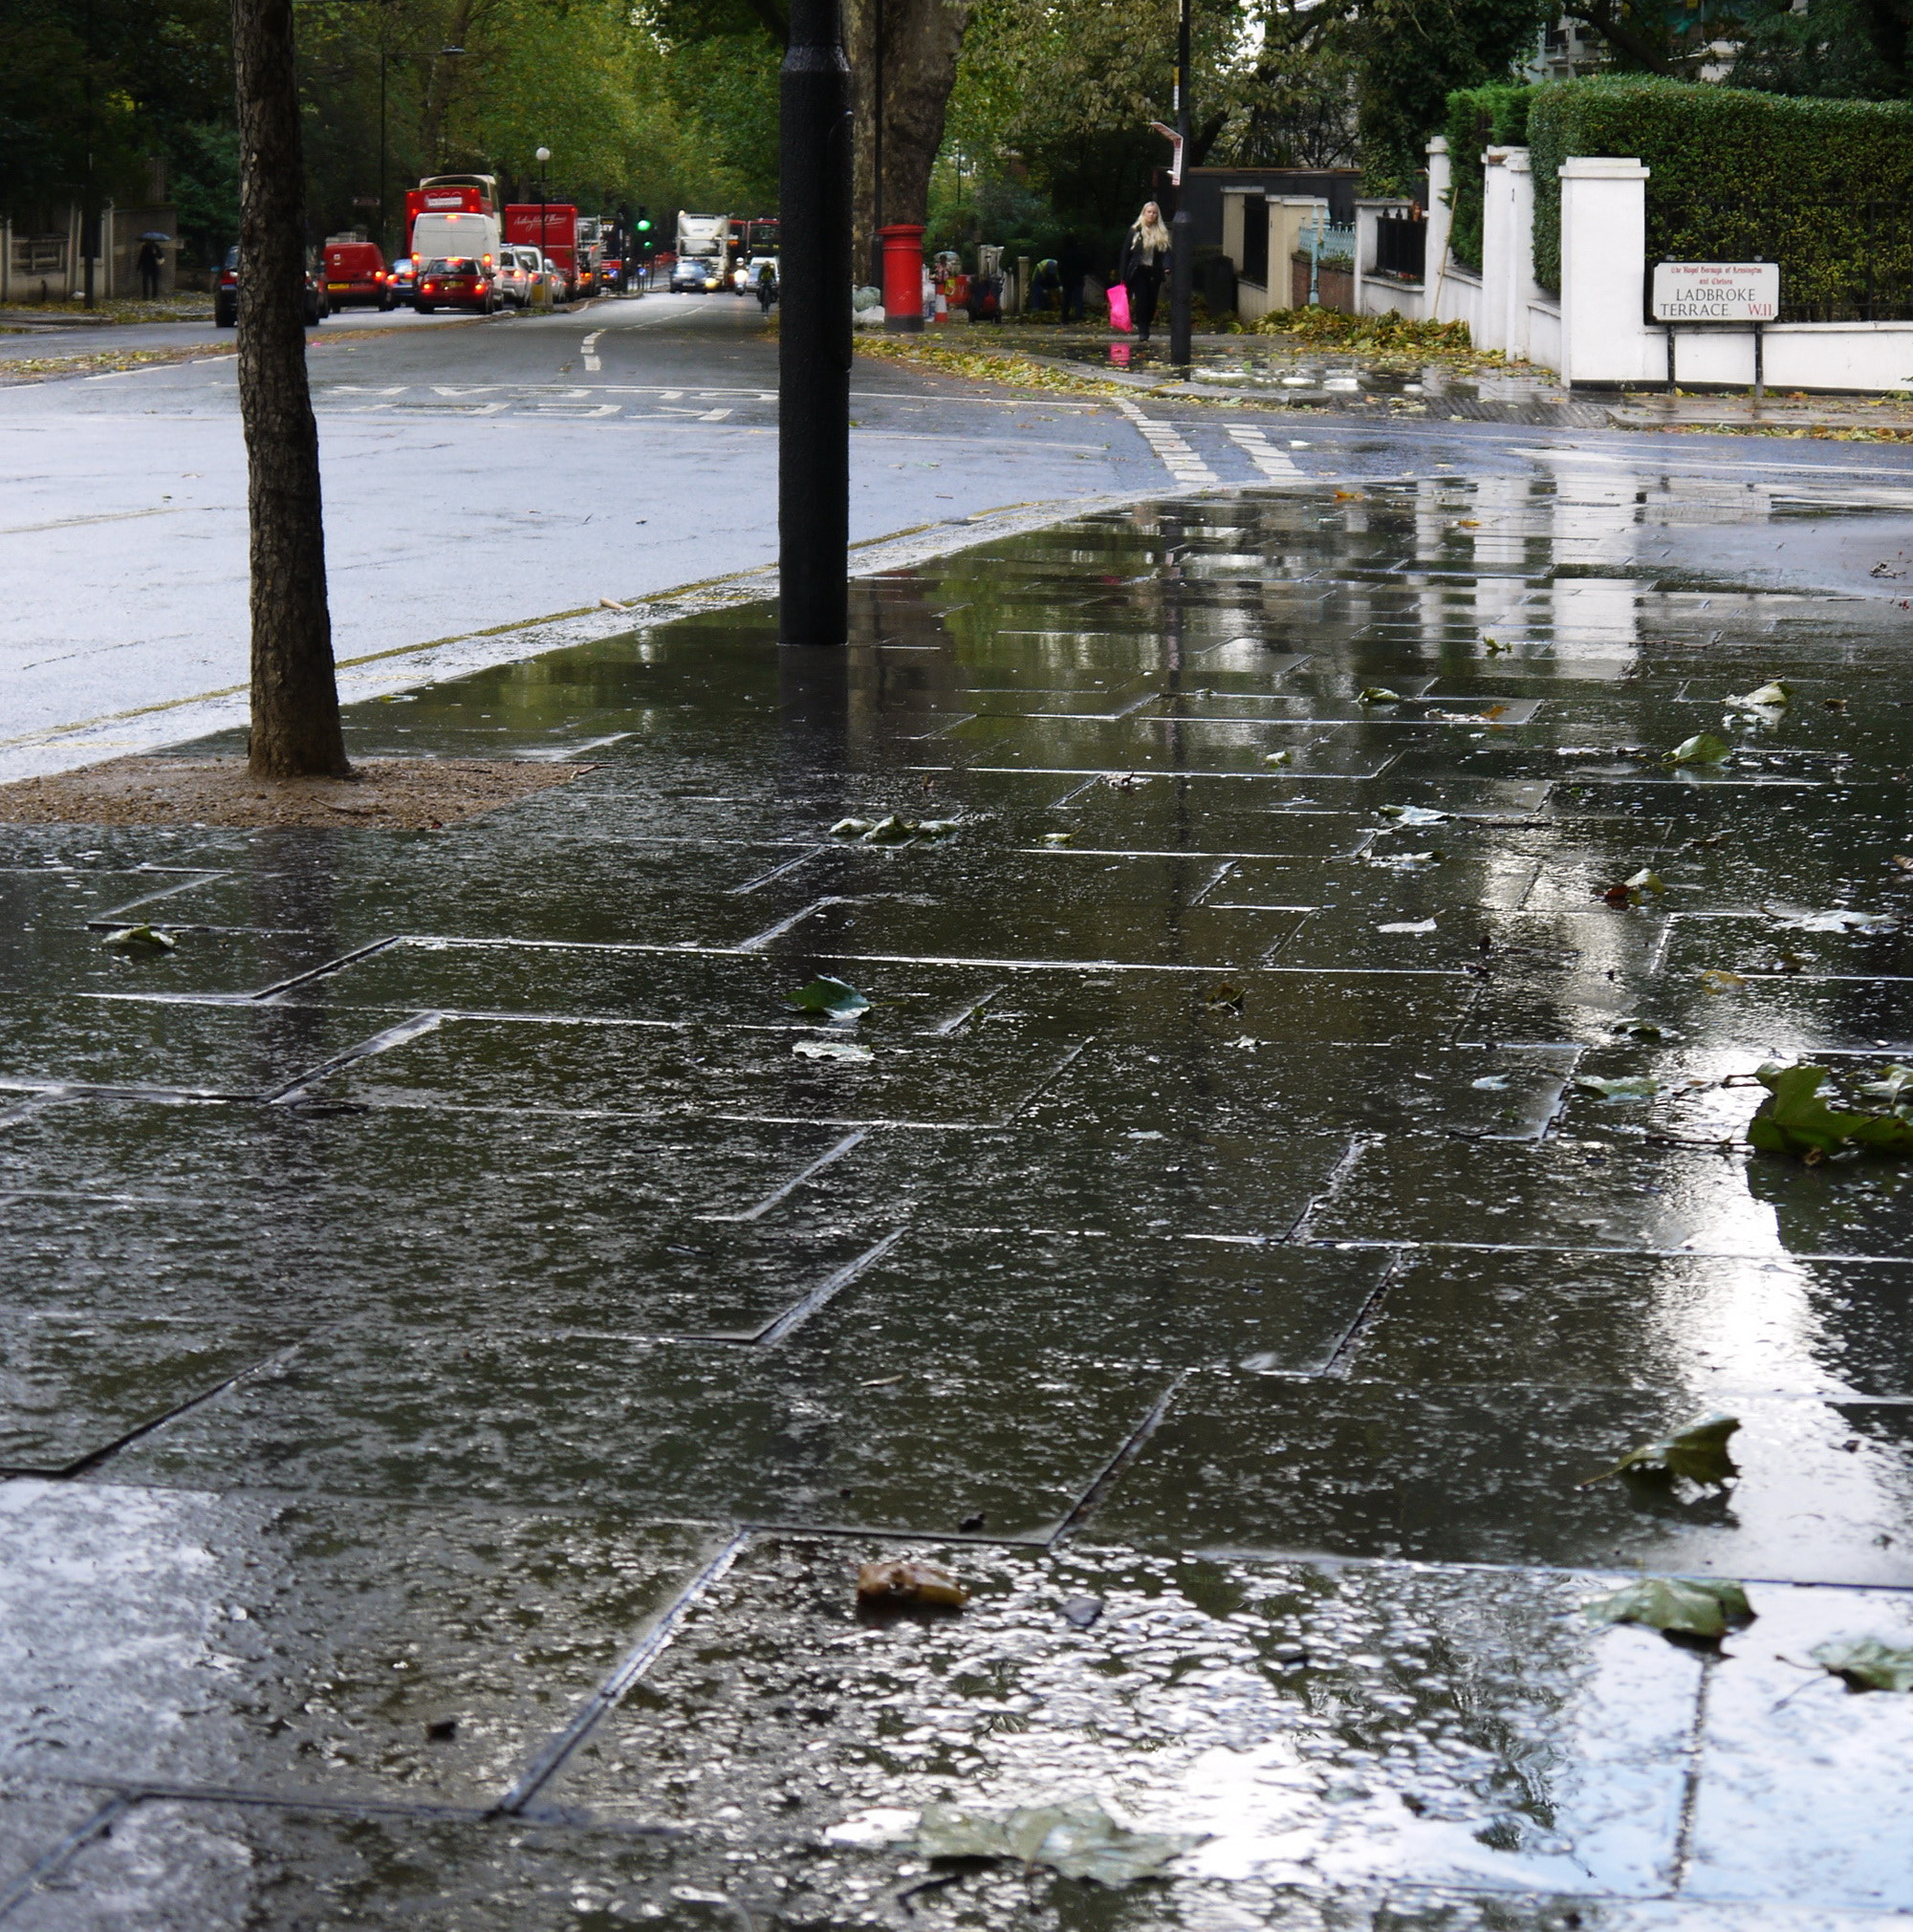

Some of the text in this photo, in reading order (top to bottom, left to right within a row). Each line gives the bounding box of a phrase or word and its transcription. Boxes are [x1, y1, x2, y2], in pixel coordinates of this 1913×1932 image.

[1683, 267, 1699, 275] Royal
[1701, 267, 1723, 275] Borough
[1732, 267, 1763, 275] Kensington
[1676, 288, 1756, 301] LADBROKE
[323, 386, 780, 401] CLEAR
